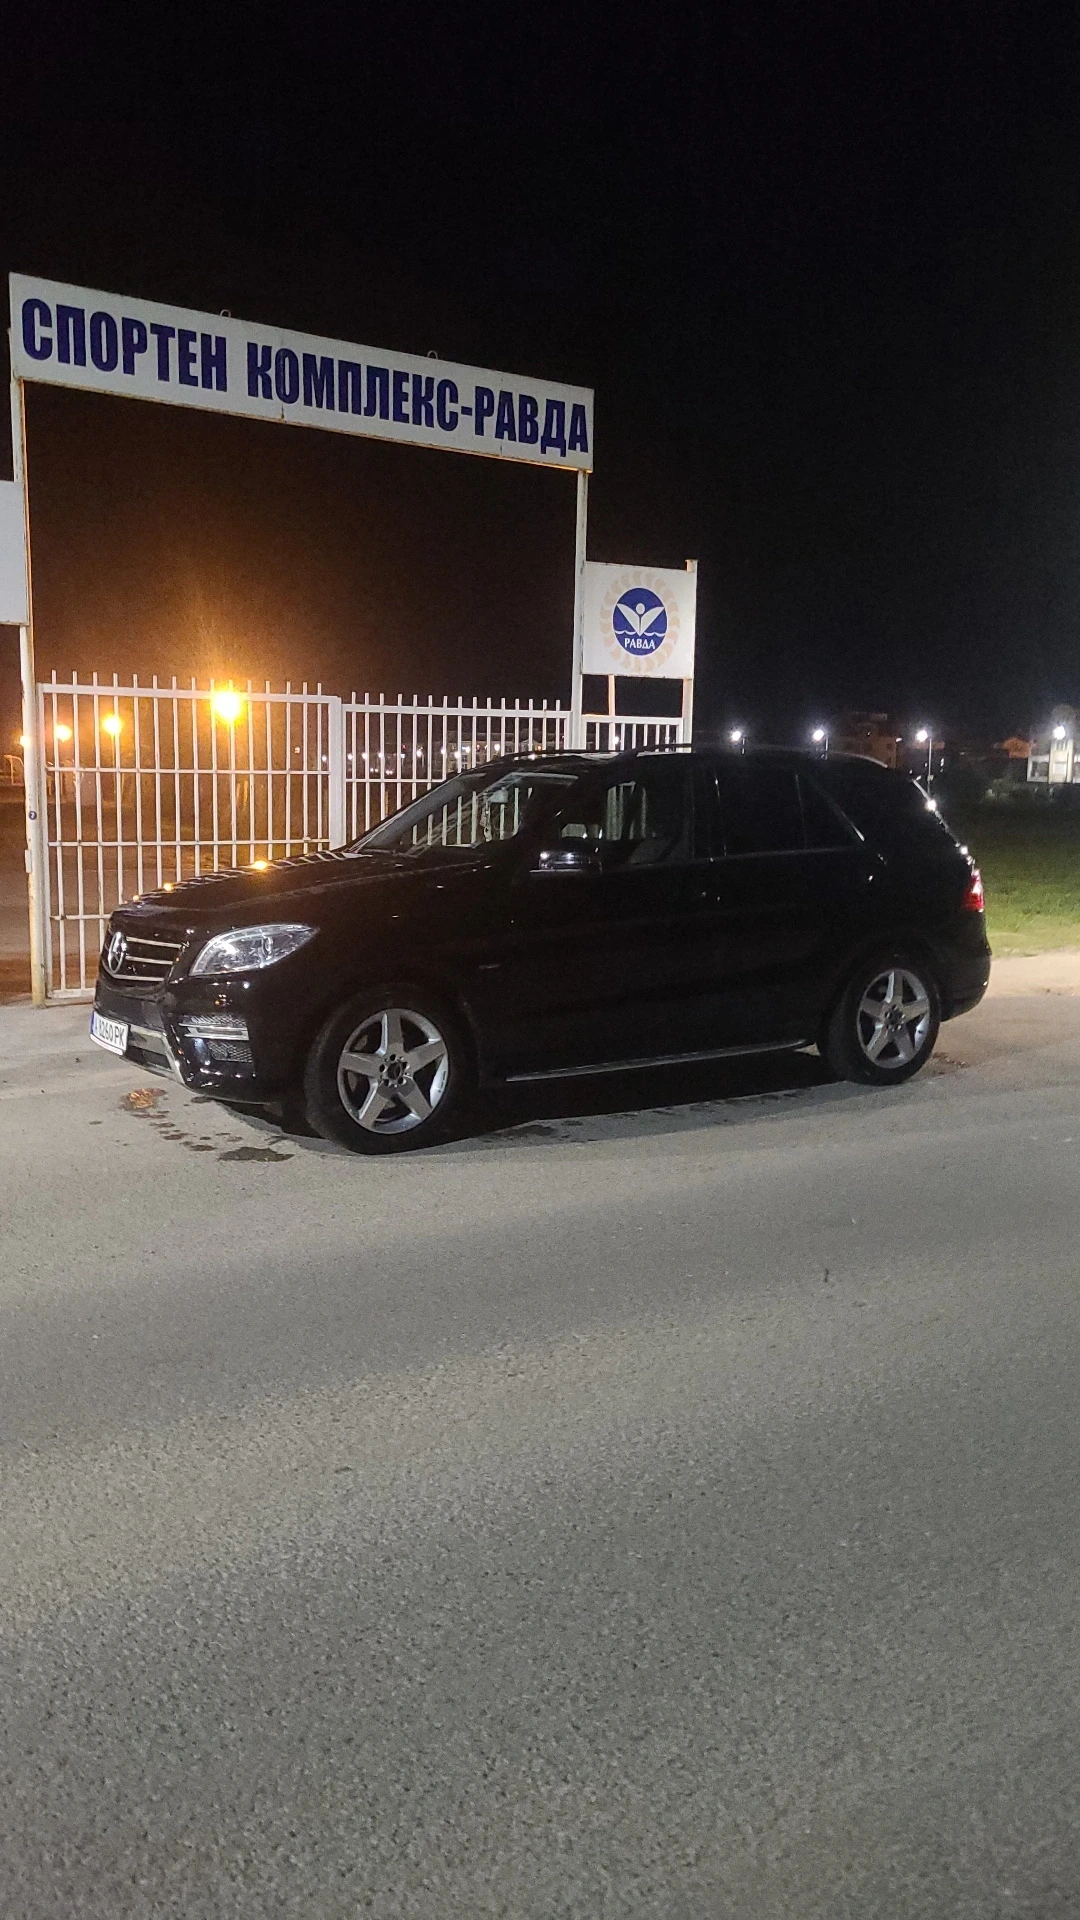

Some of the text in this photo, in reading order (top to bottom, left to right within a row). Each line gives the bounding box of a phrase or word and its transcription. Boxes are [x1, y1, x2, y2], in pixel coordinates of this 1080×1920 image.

[21, 298, 589, 457] СПОРТЕН КОМПЛЕКС-РАВДА
[624, 637, 656, 649] РАВДА
